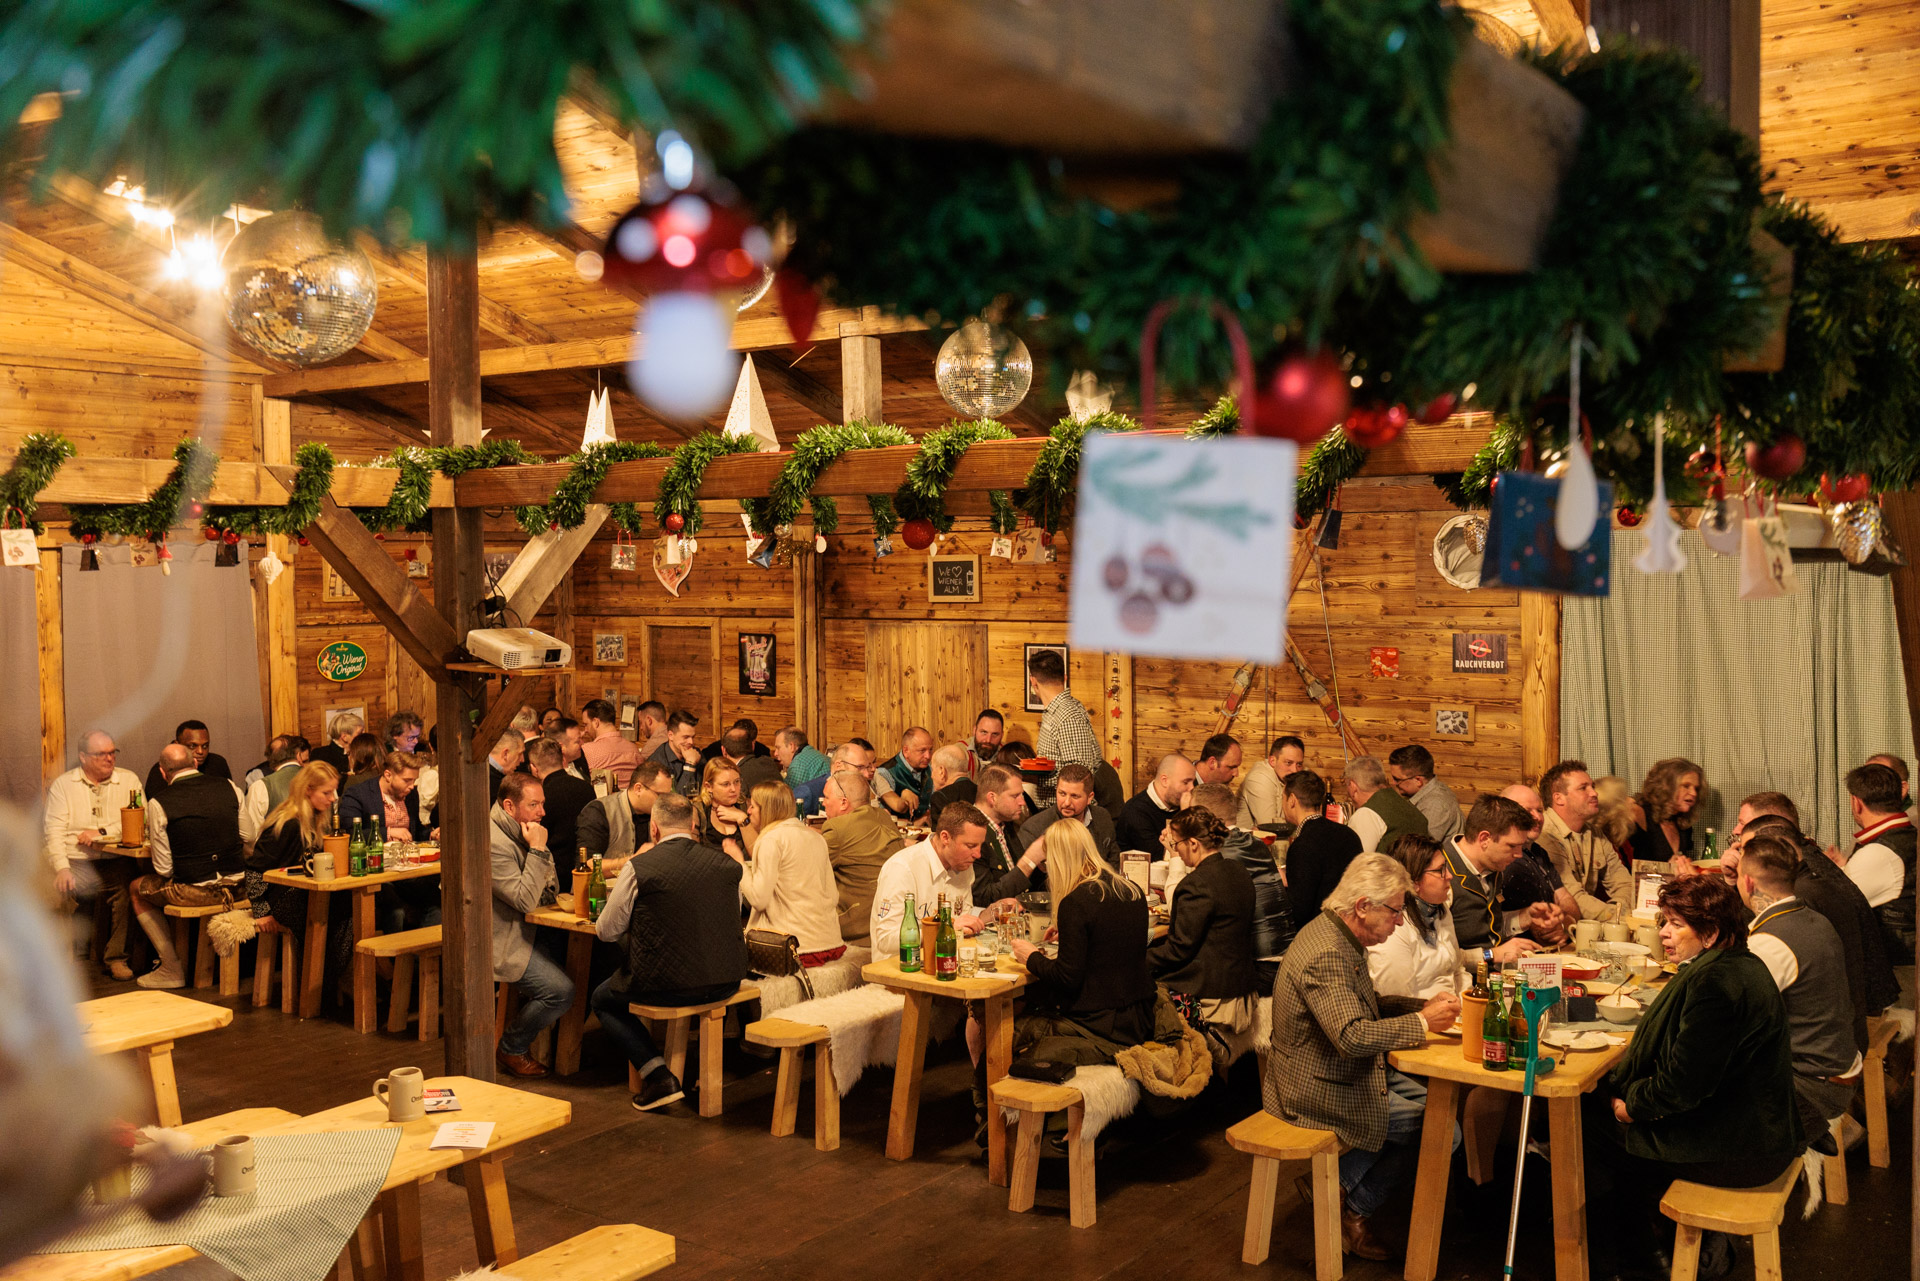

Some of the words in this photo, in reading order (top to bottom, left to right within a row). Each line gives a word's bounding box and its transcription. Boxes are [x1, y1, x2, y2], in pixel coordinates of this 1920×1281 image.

[938, 566, 951, 576] WE
[937, 577, 963, 586] WIENER
[944, 585, 960, 594] ALM
[342, 653, 365, 665] Wiener
[1455, 660, 1505, 669] RAUCHVERBOT
[336, 662, 363, 677] Original
